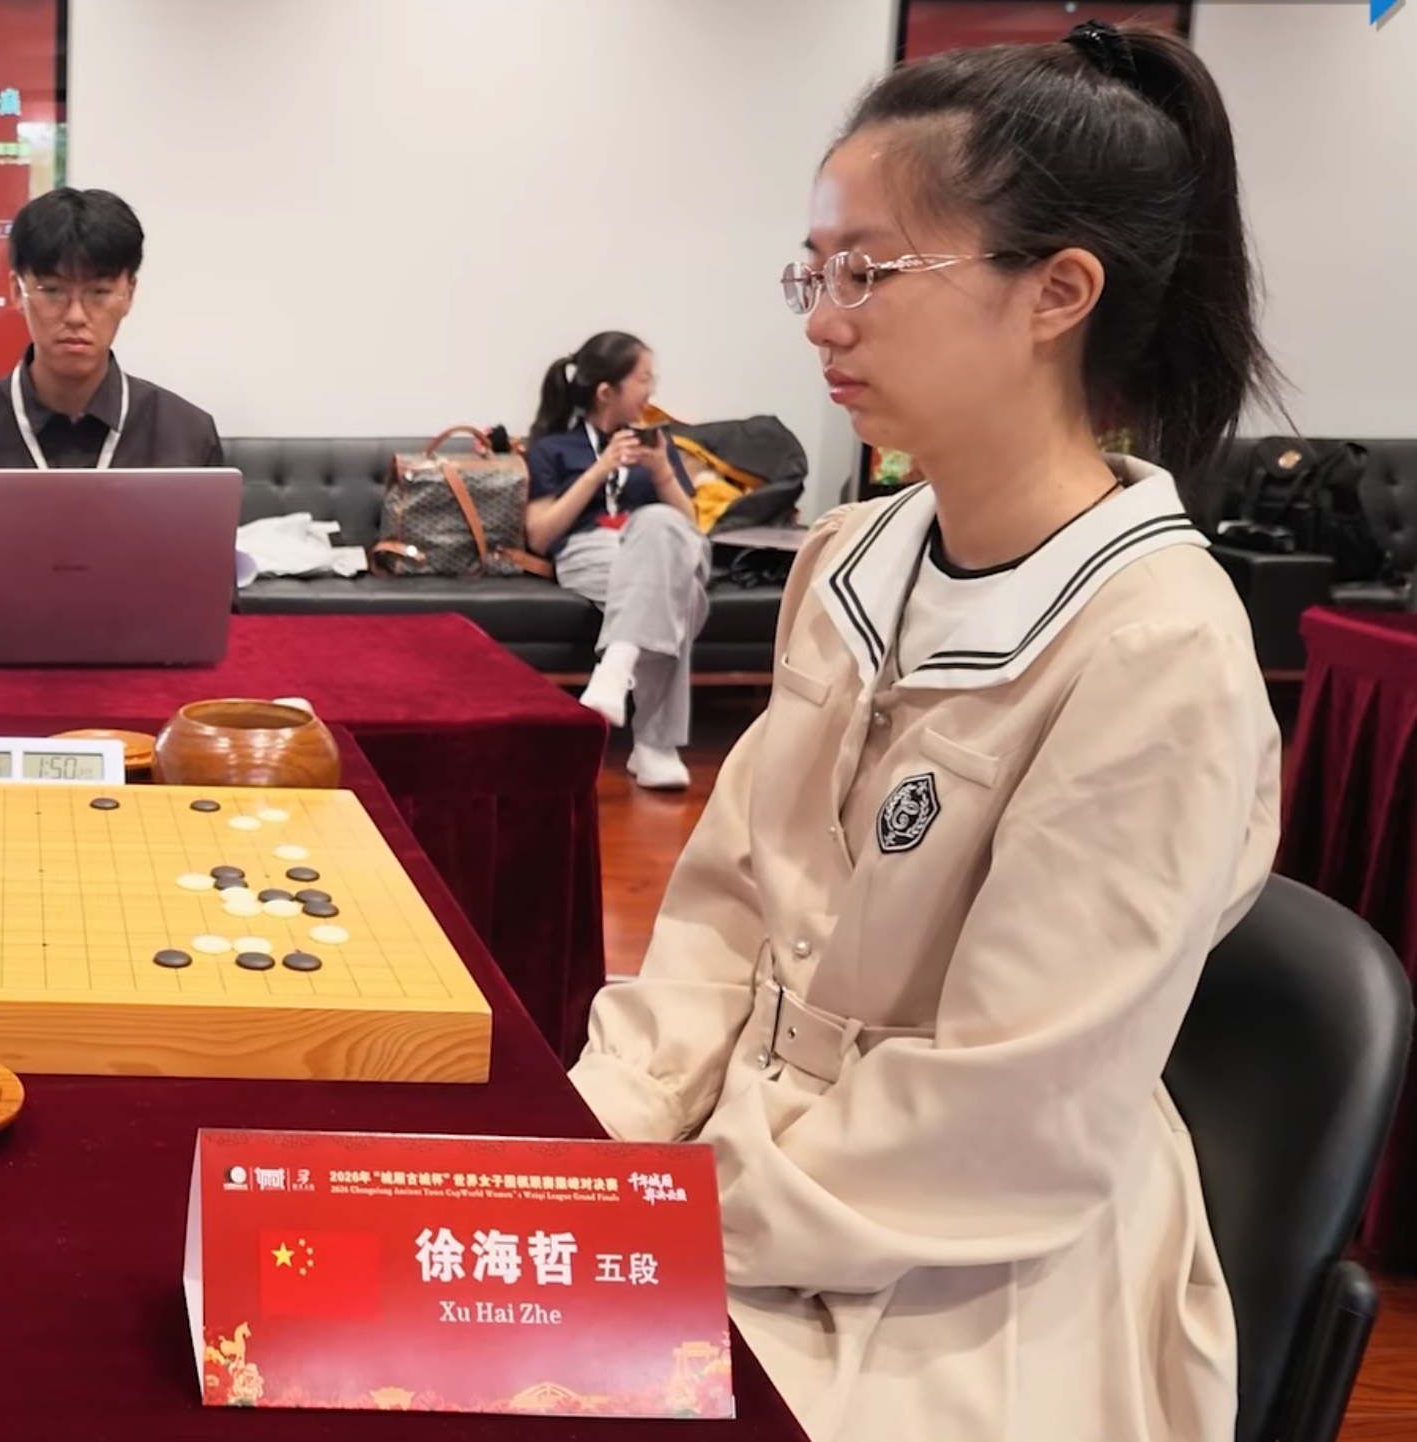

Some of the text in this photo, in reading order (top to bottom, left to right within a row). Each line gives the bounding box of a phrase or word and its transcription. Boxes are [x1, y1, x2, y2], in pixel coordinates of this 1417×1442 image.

[39, 756, 77, 779] 1:50
[415, 1228, 660, 1286] 徐海哲 五段
[439, 1301, 562, 1325] Xu Hai Zhe
